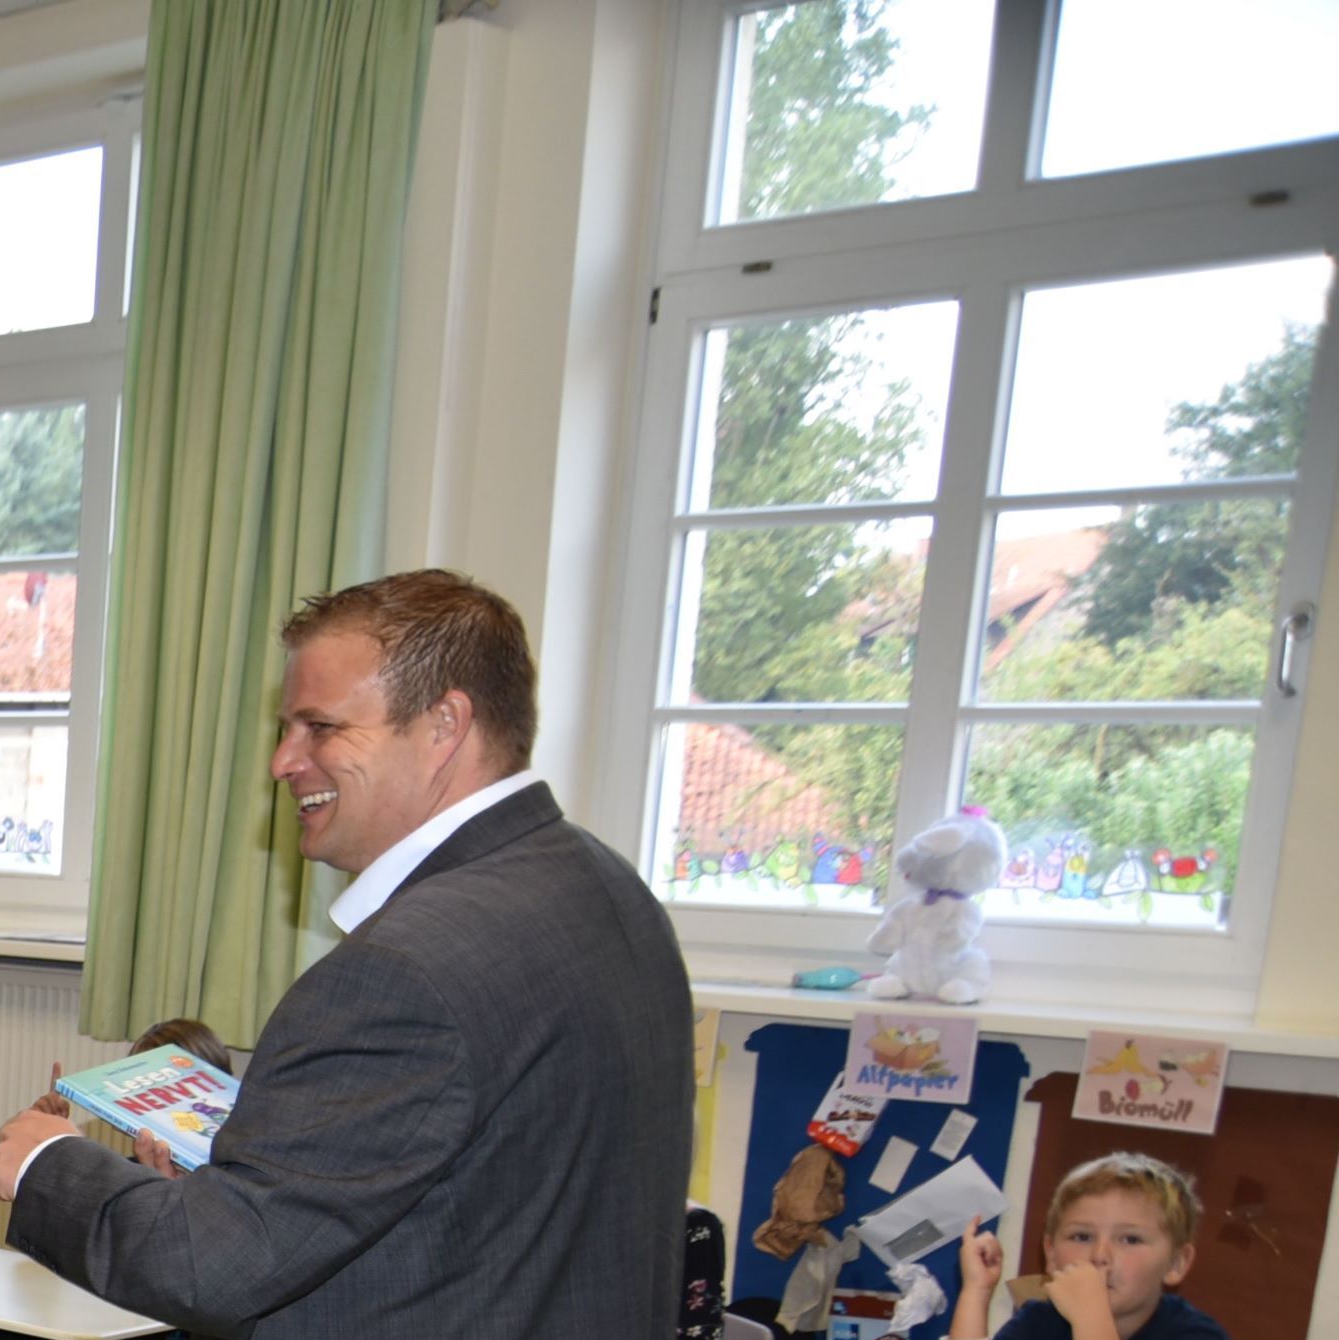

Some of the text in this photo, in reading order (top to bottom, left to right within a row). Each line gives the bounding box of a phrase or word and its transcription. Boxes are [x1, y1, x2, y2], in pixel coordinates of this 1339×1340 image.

[103, 1067, 182, 1095] Lesen
[114, 1070, 227, 1116] NERVT!
[856, 1064, 960, 1097] Altpapier
[1097, 1089, 1194, 1123] Biomüll
